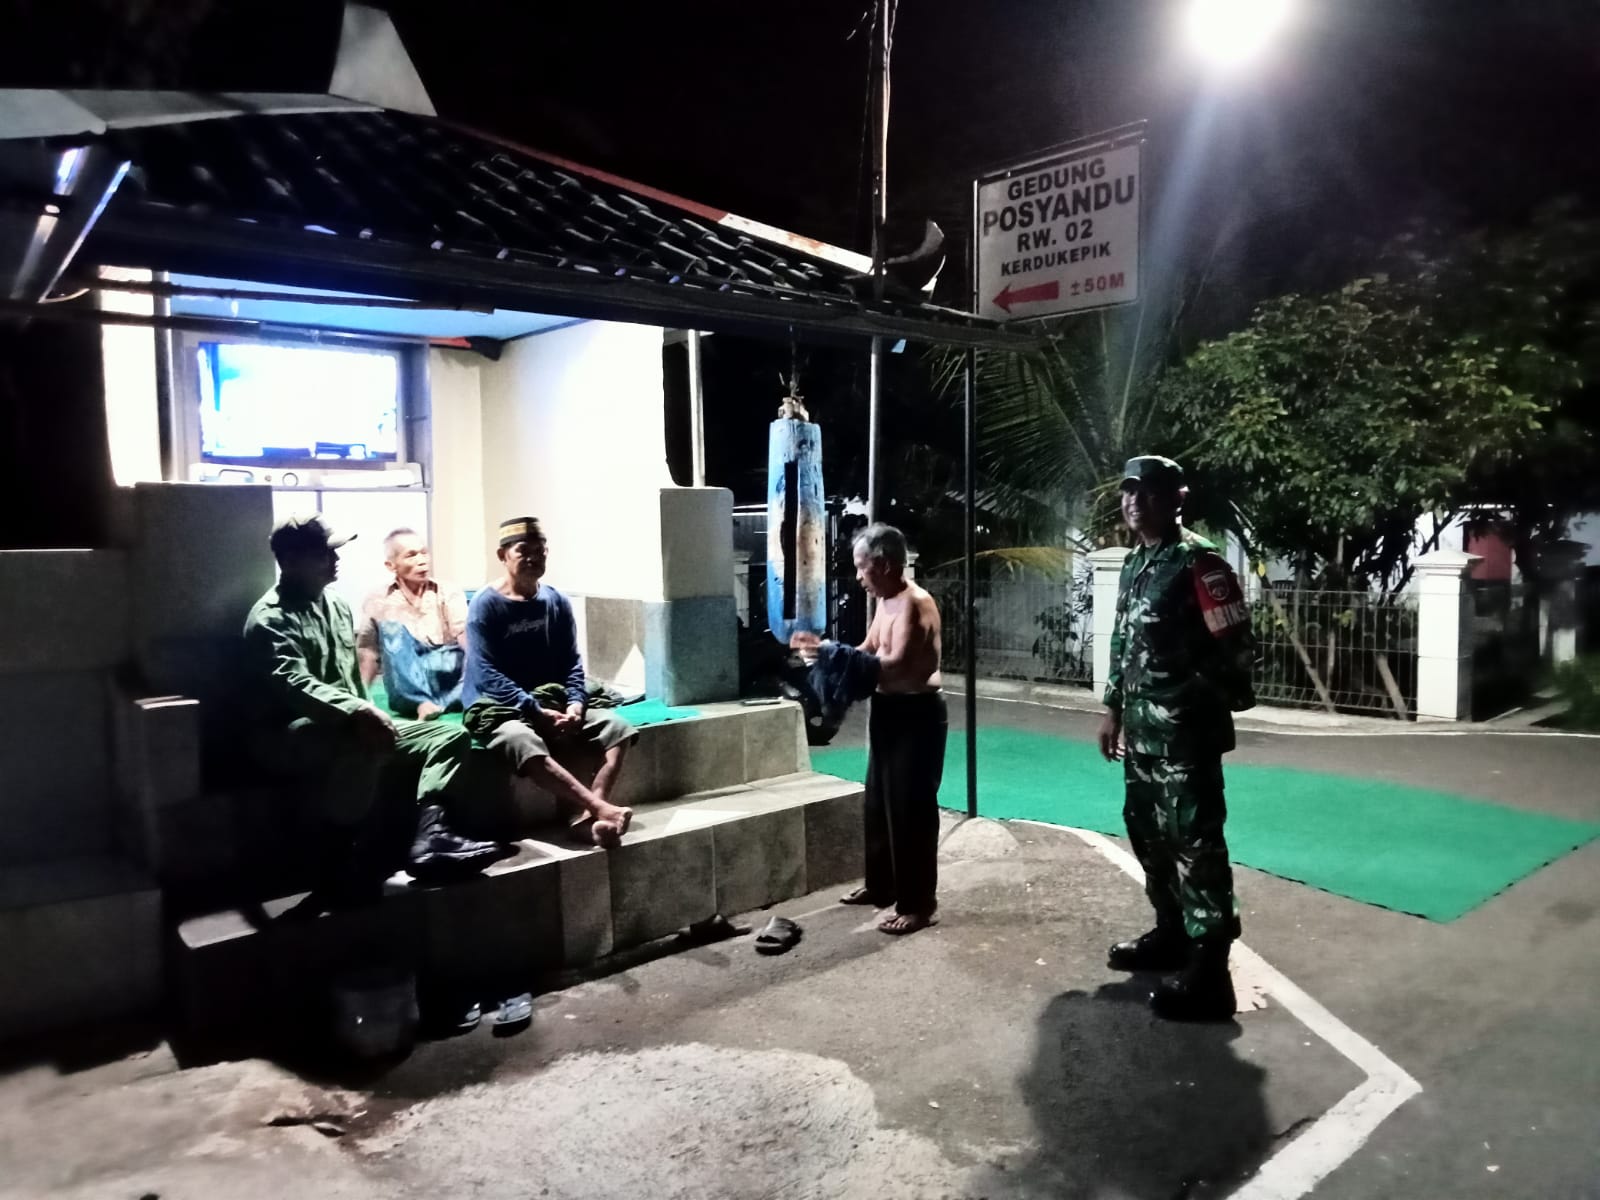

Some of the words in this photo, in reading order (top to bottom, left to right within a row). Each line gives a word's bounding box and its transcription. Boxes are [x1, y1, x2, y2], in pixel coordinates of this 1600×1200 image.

[1007, 158, 1106, 201] GEDUNG
[983, 175, 1135, 237] POSYANDU
[1017, 228, 1057, 252] RW.
[1065, 218, 1094, 243] 02
[1001, 241, 1112, 276] KERDUKEPIK
